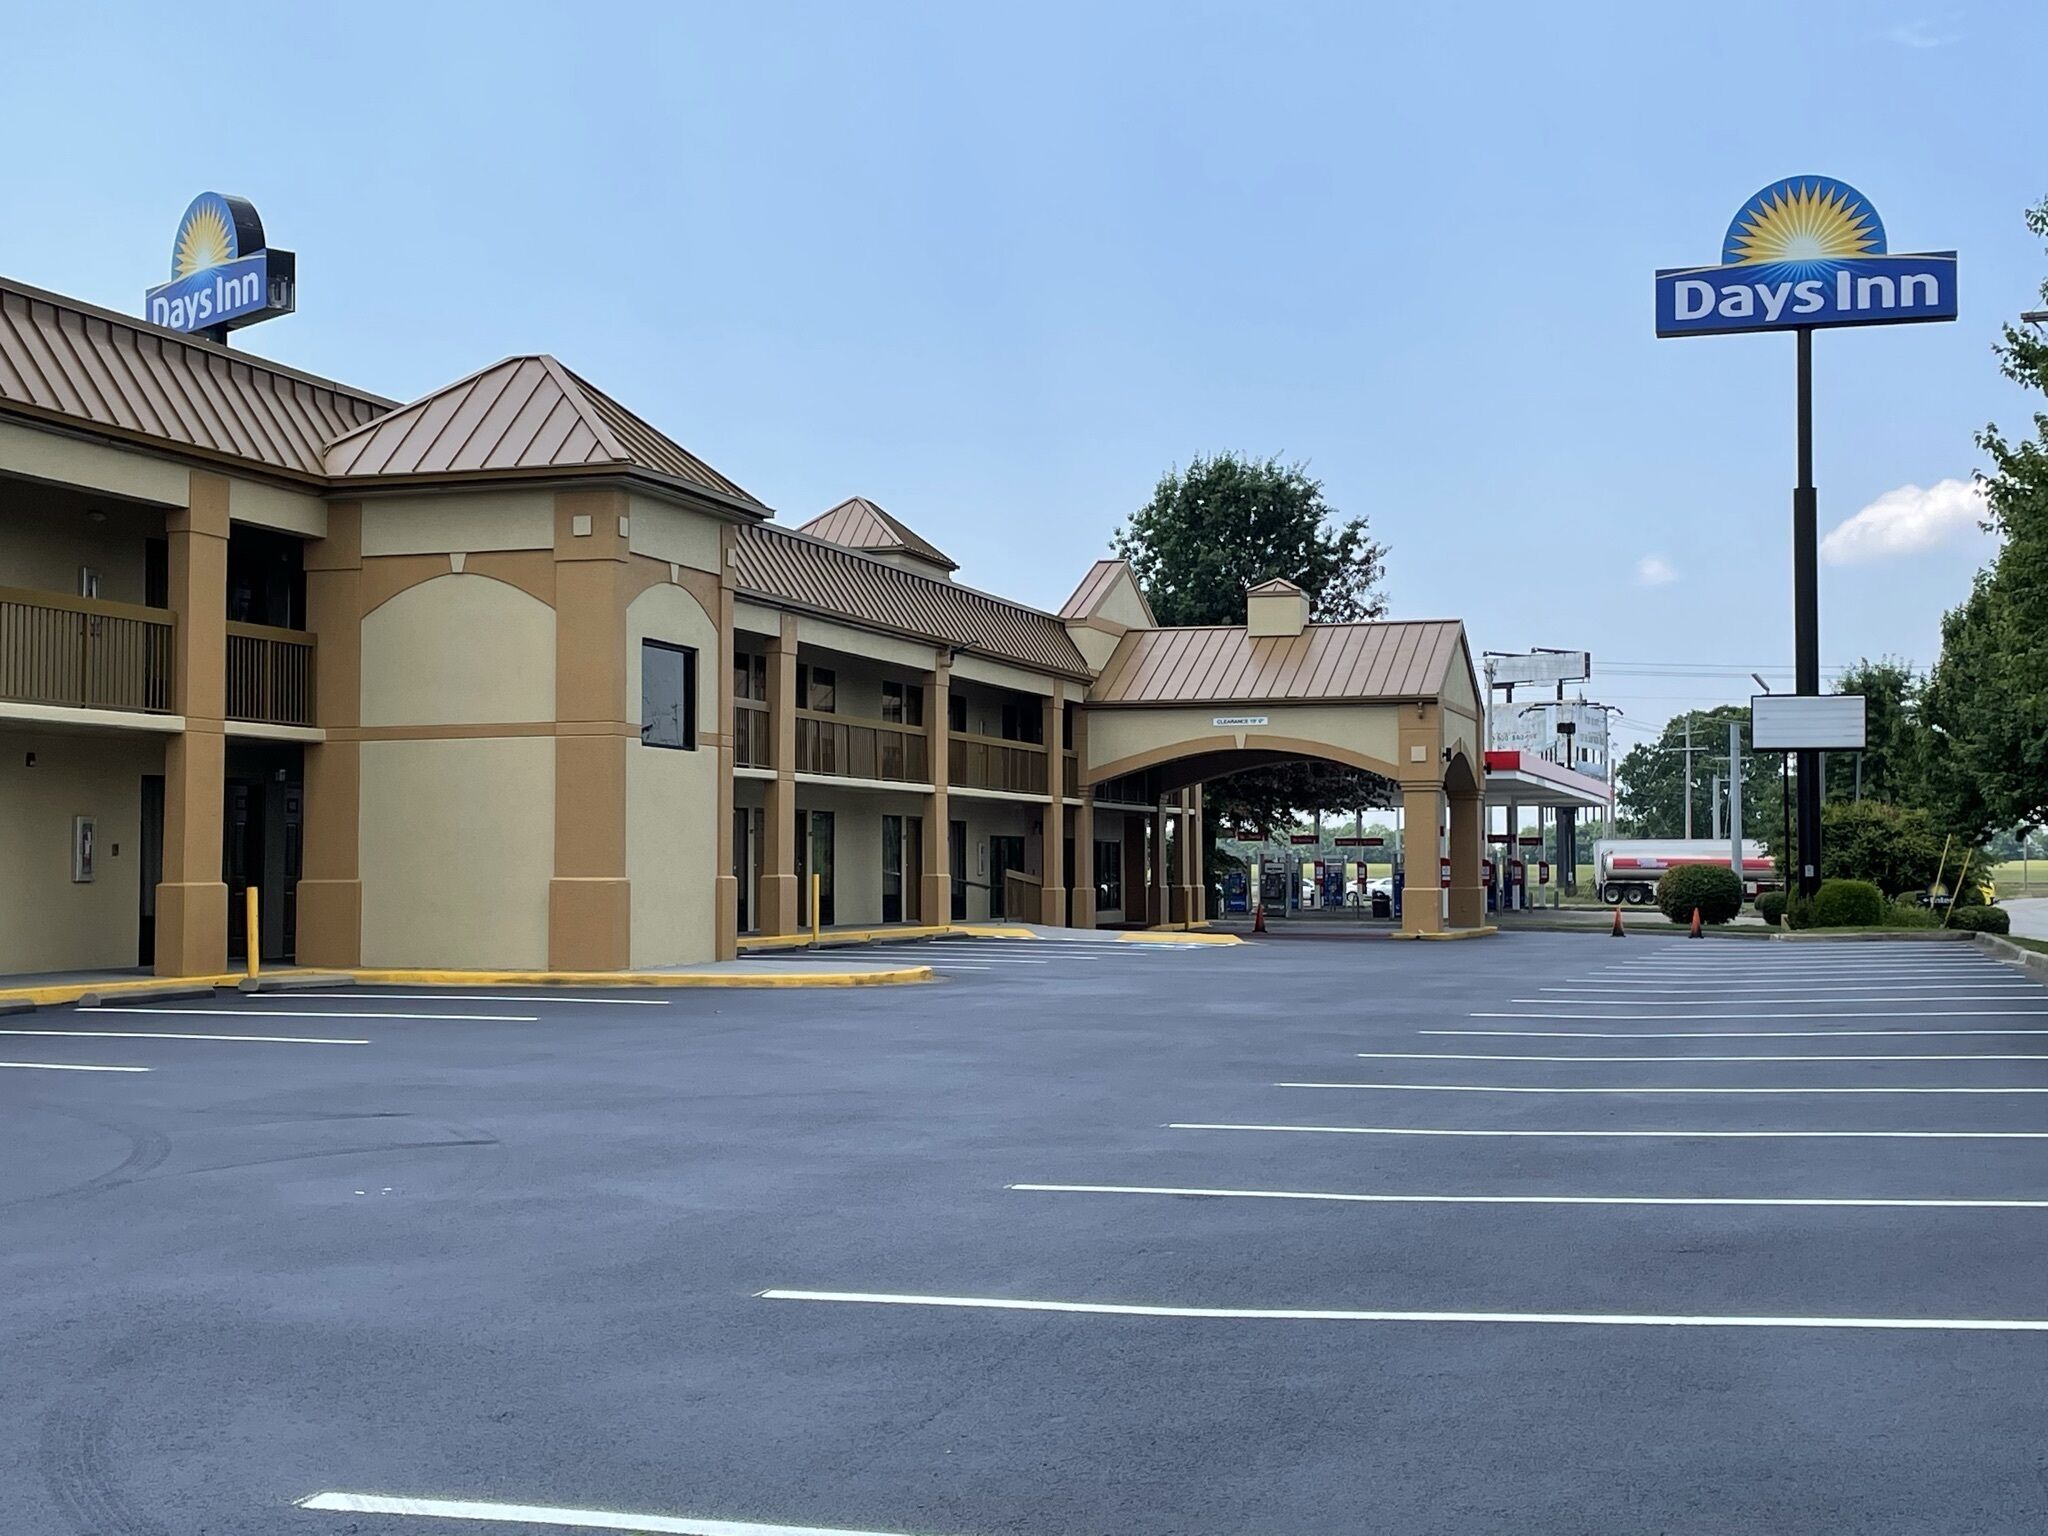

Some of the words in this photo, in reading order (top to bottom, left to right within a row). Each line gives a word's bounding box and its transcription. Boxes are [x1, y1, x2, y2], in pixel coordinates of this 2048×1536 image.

[152, 287, 213, 329] Days
[216, 272, 259, 314] Inn
[1674, 279, 1825, 321] Days
[1836, 270, 1939, 311] Inn
